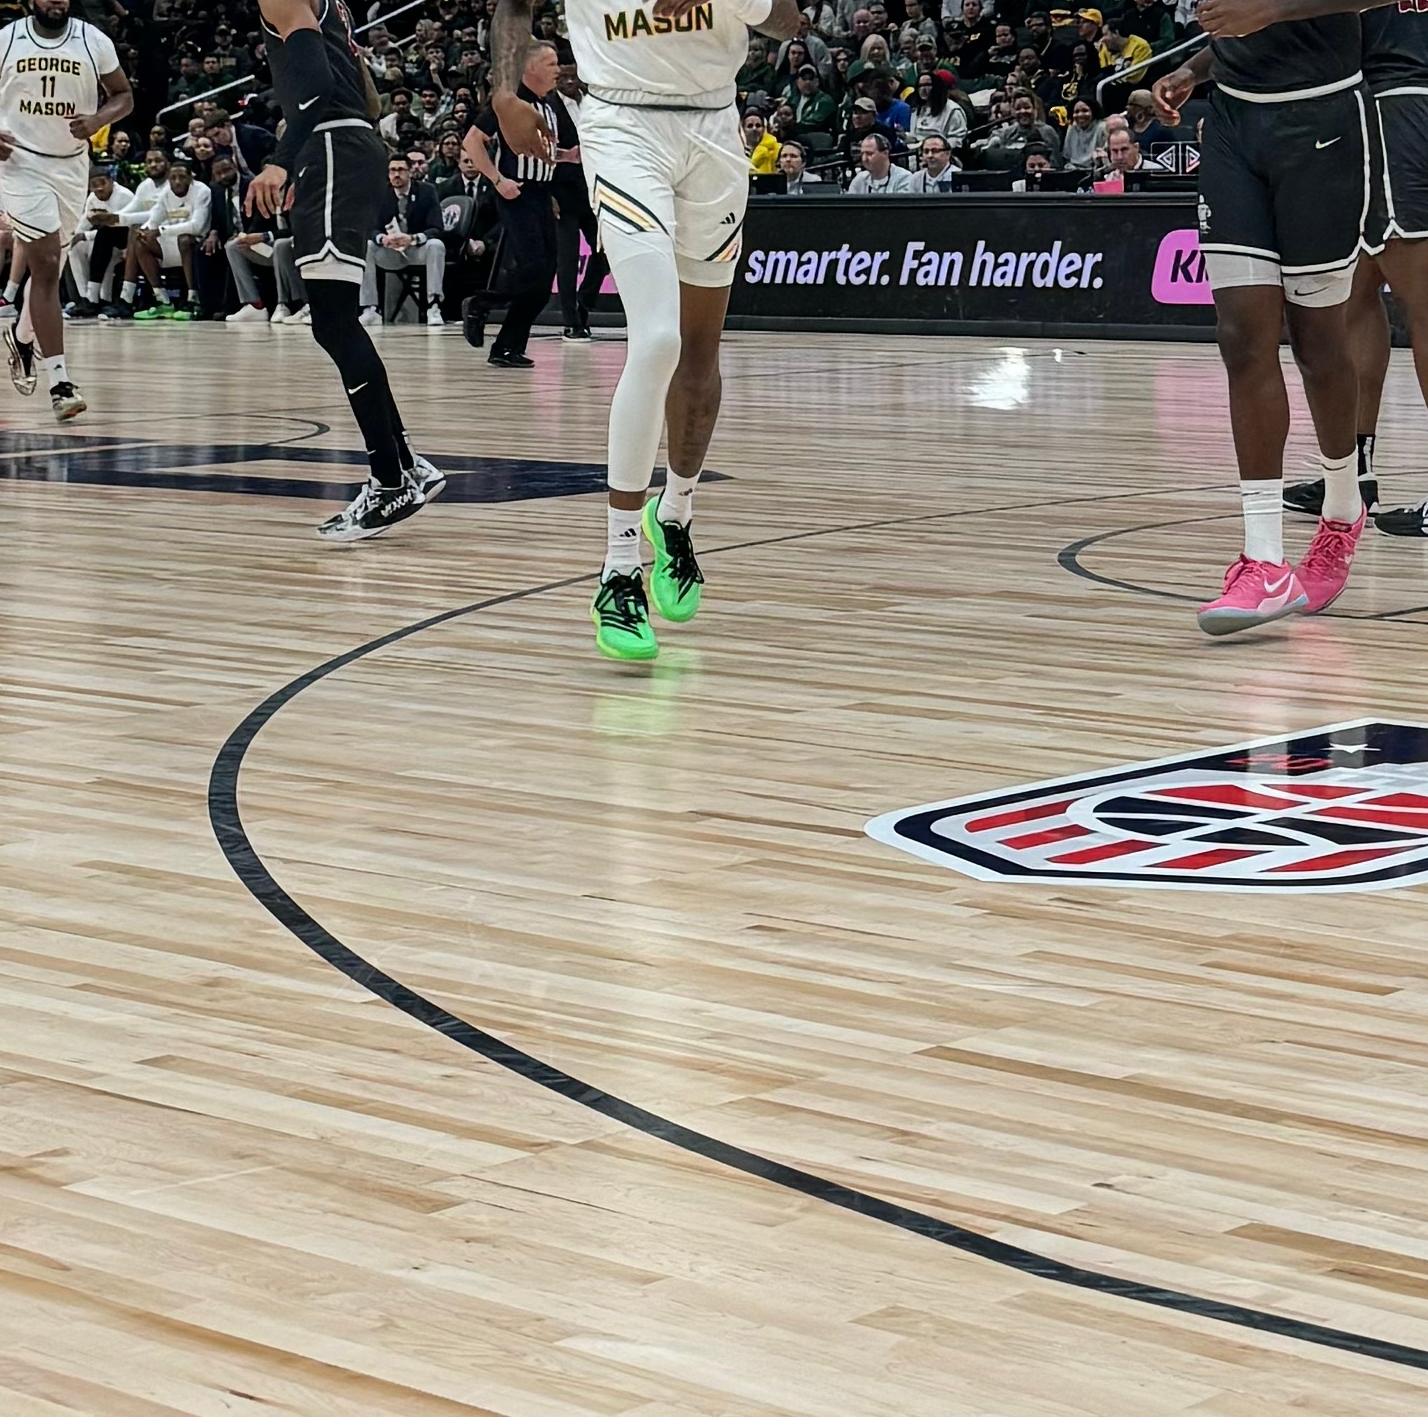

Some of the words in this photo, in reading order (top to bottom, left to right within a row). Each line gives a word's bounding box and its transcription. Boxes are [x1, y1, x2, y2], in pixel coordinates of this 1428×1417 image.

[604, 2, 714, 41] MASON
[16, 57, 81, 76] GEORGE
[40, 75, 56, 98] 11
[19, 99, 76, 116] MASON
[744, 242, 889, 288] smarter.
[899, 240, 965, 286] Fan
[972, 239, 1104, 289] harder.
